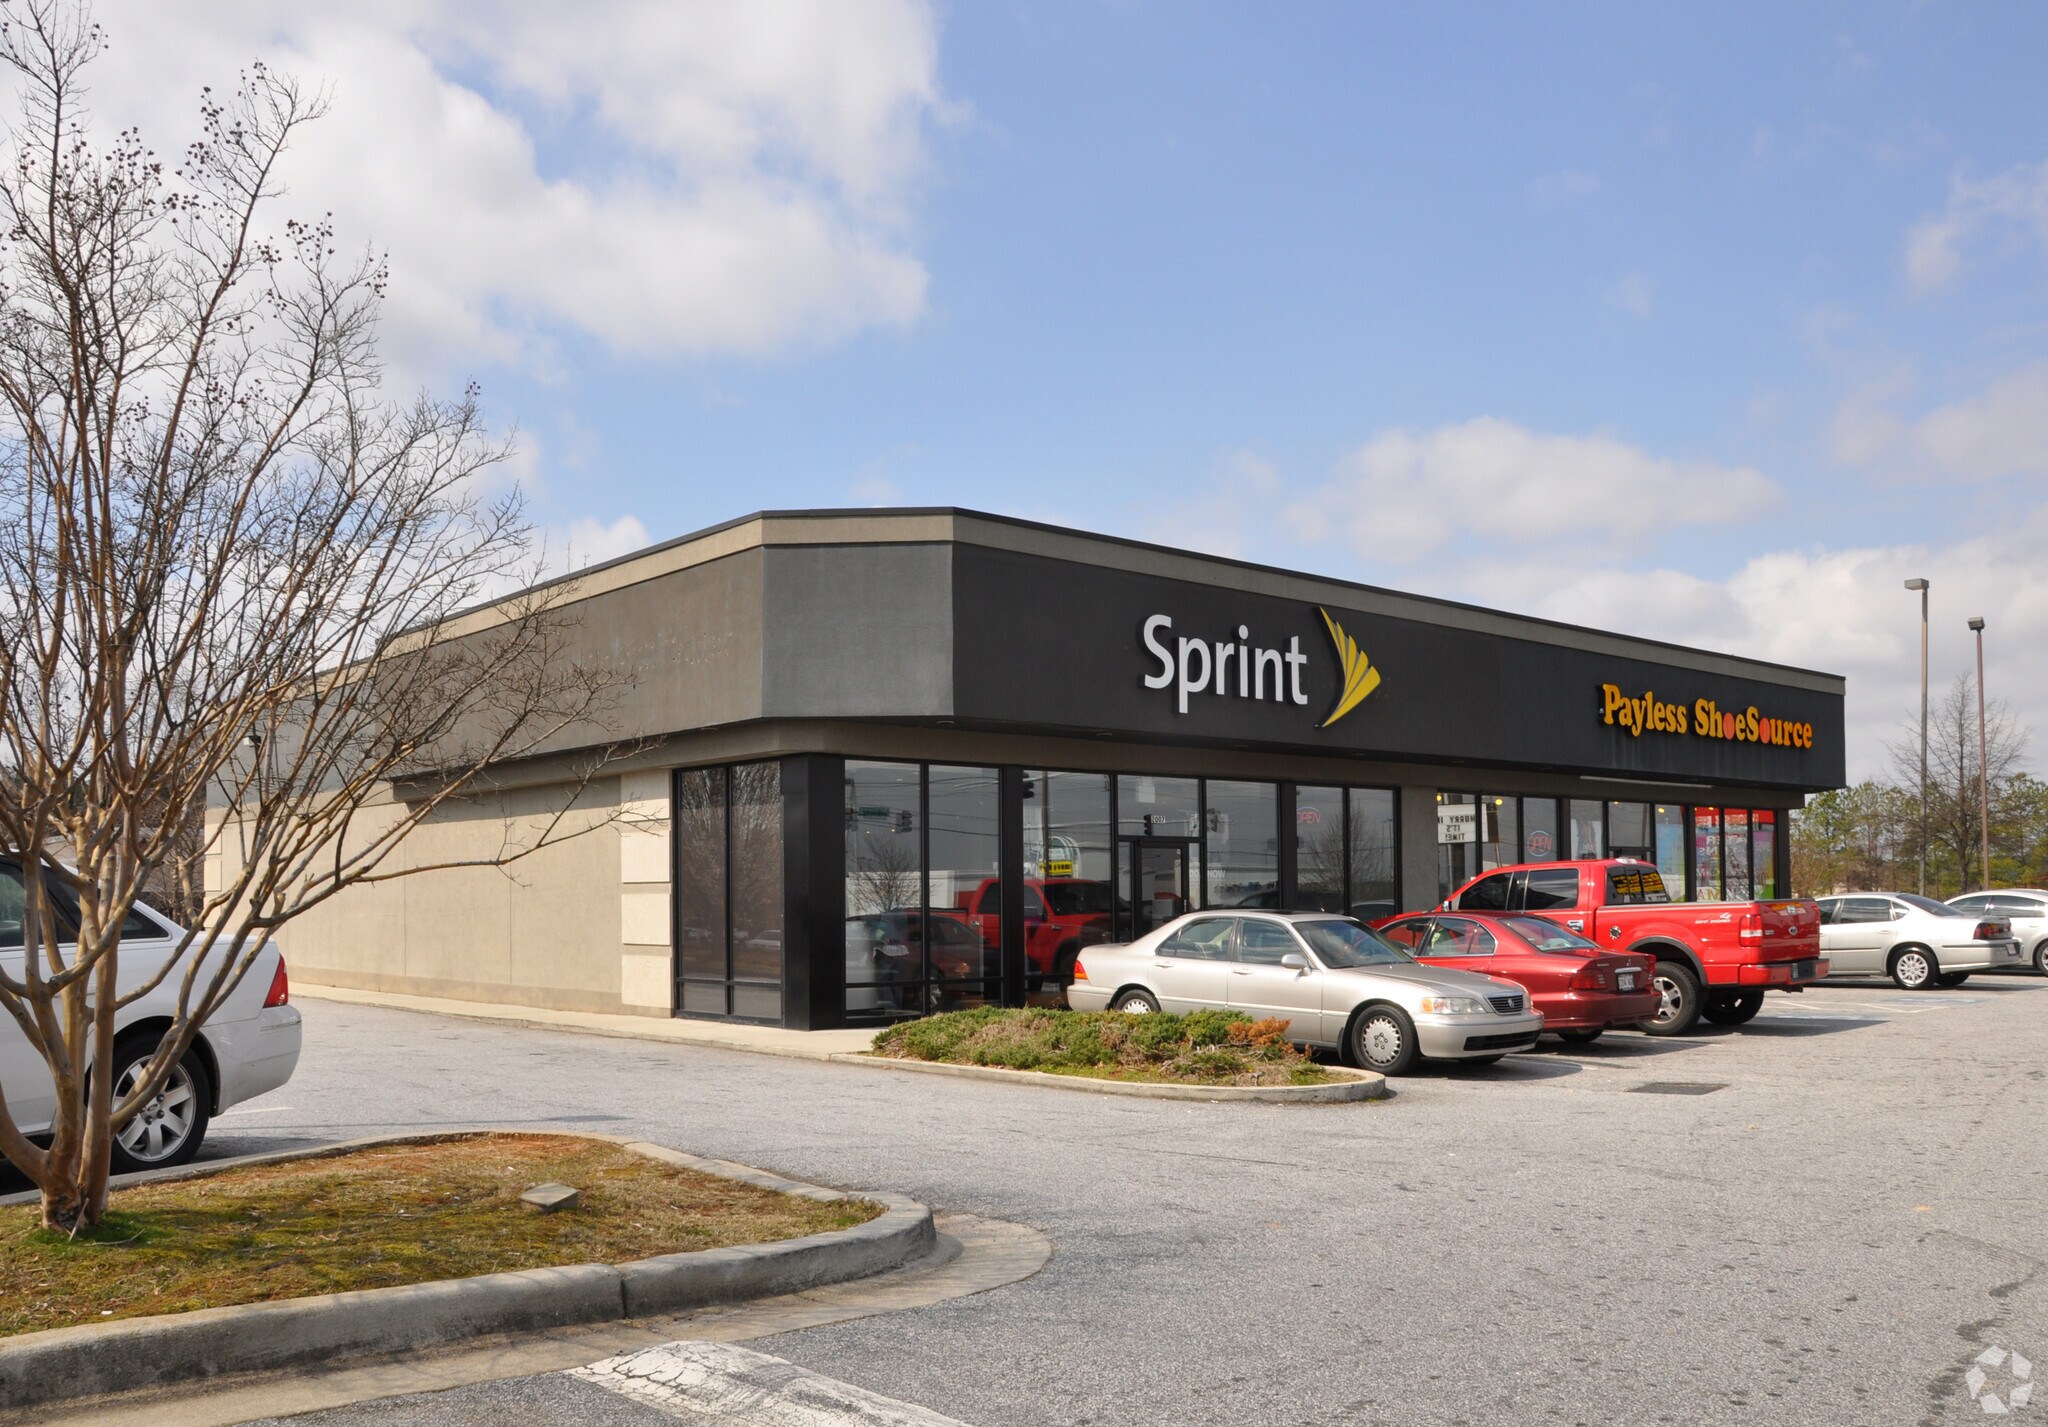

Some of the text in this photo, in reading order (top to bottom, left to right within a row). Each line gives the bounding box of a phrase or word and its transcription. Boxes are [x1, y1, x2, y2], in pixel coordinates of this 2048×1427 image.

[1143, 614, 1309, 714] Sprint
[1602, 683, 1813, 749] Payless ShoeSource
